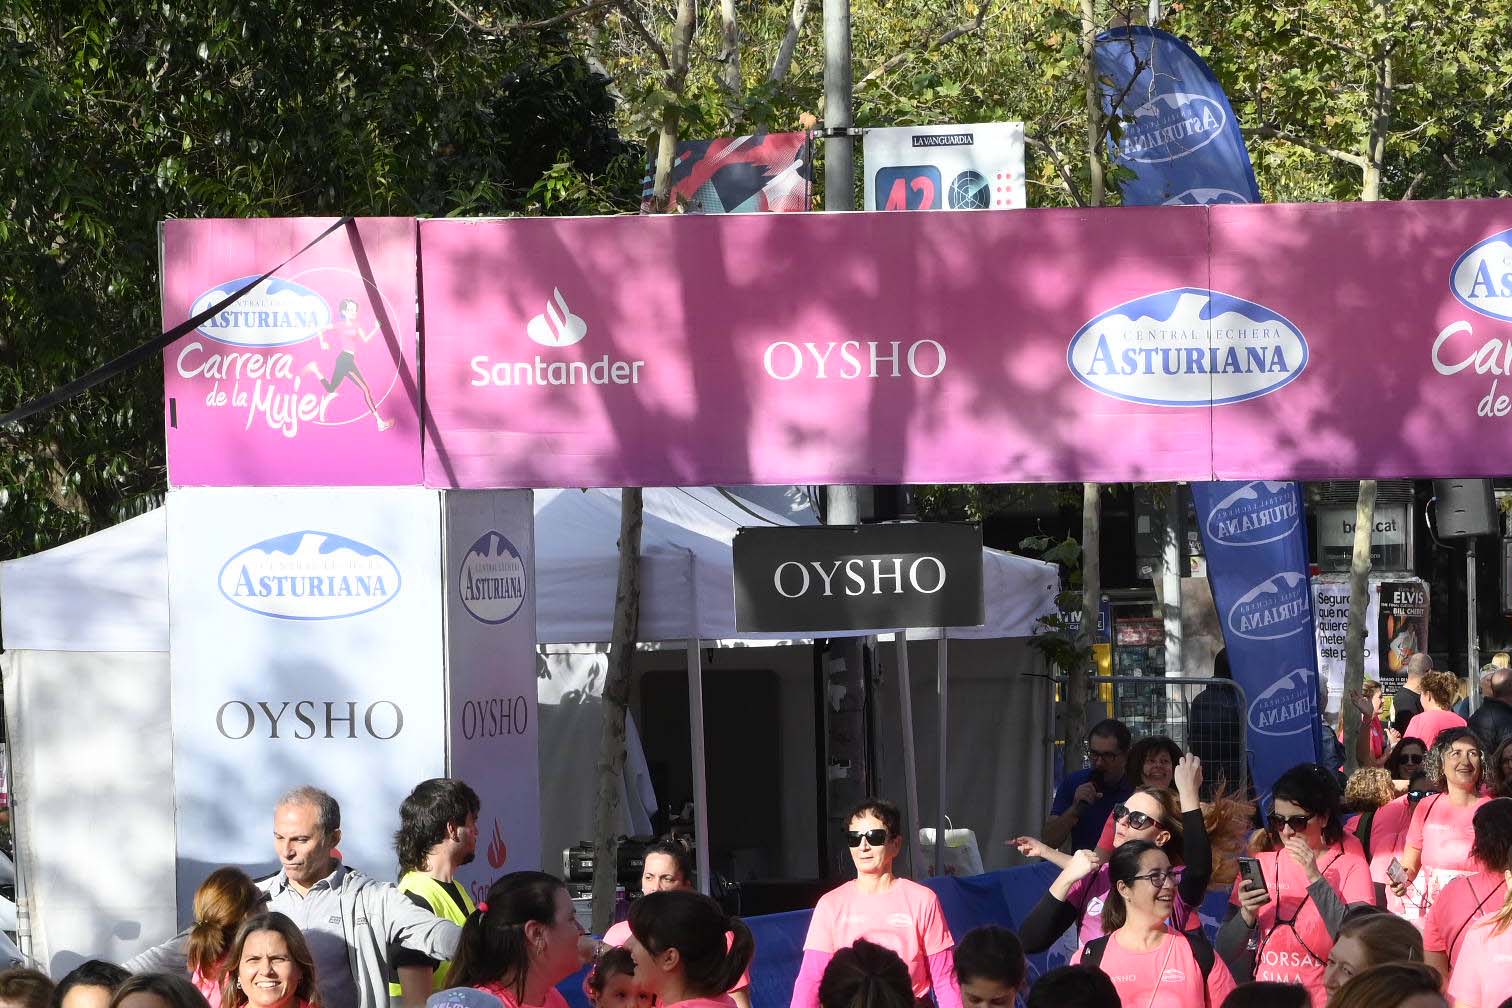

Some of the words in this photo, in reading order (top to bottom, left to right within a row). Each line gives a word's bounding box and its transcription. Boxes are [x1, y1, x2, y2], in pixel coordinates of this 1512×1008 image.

[1123, 327, 1199, 341] CENTRAL
[1204, 326, 1281, 340] LECHERA
[176, 341, 295, 380] Carrera
[470, 354, 646, 388] Santander
[762, 338, 948, 381] OYSHO
[1087, 332, 1290, 377] ASTURIANA
[205, 383, 228, 408] de
[231, 381, 249, 408] la
[245, 375, 340, 438] Mujer
[1476, 379, 1512, 418] de
[1342, 519, 1398, 534] b.cat
[233, 563, 388, 598] ASTURIANA
[464, 565, 523, 601] ASTURIANA
[773, 556, 947, 598] OYSHO
[1393, 591, 1424, 604] ELVIS
[1320, 646, 1338, 658] este
[215, 699, 404, 741] OYSHO
[462, 694, 528, 741] OYSHO
